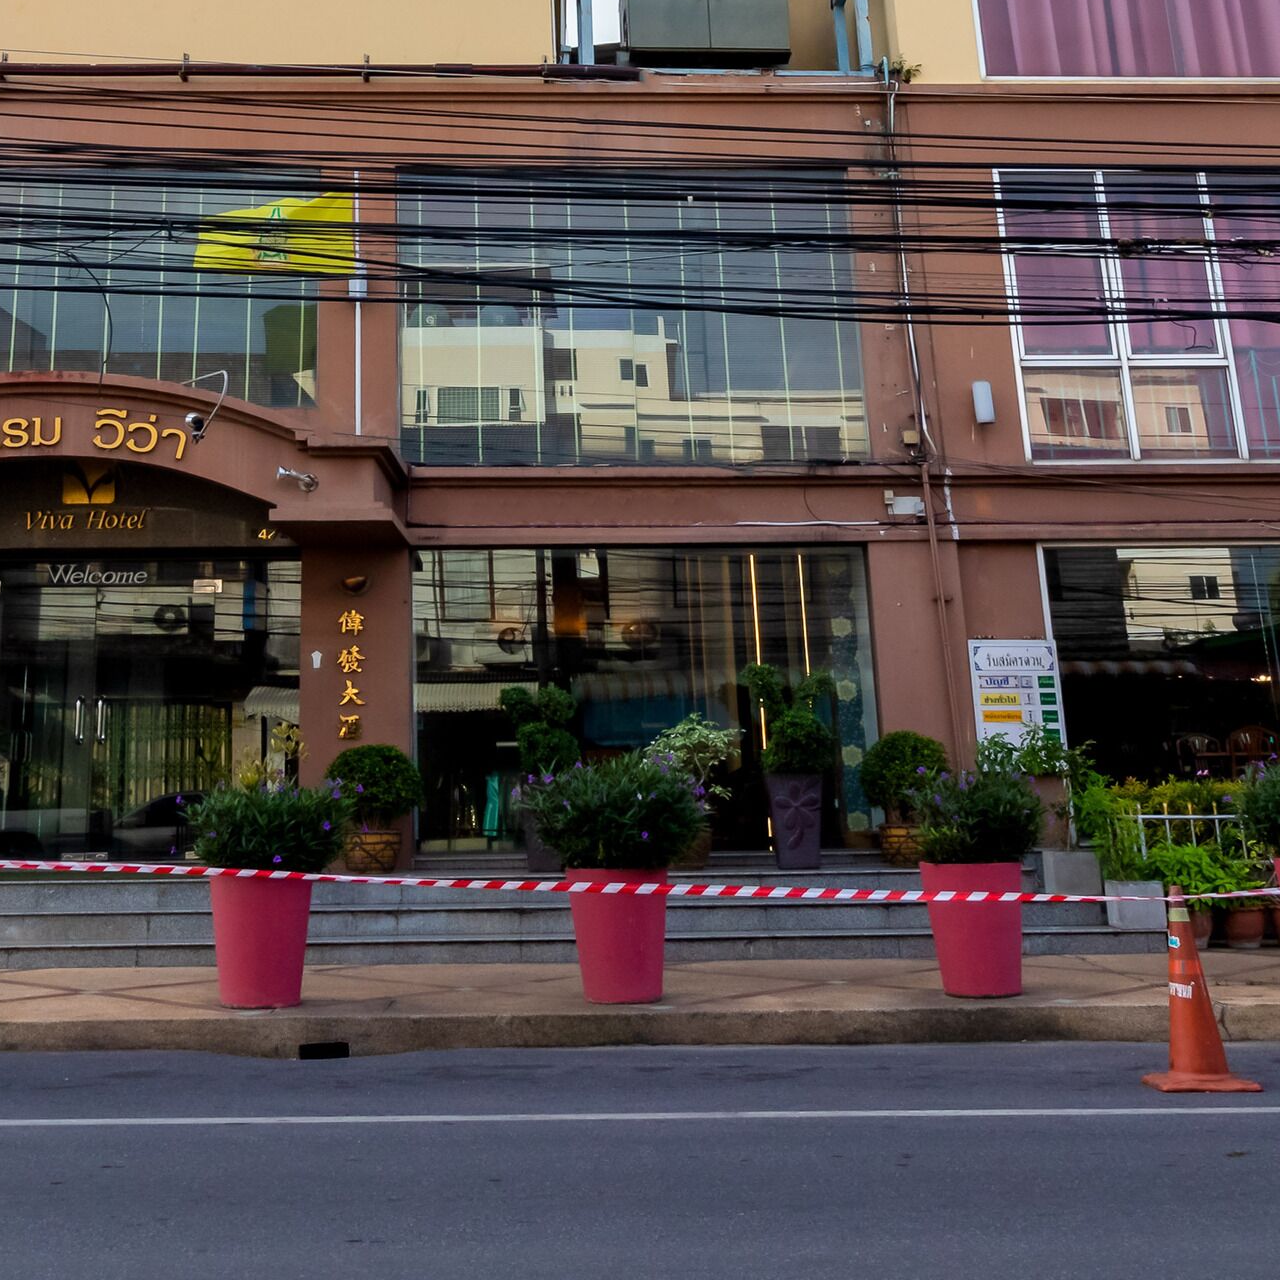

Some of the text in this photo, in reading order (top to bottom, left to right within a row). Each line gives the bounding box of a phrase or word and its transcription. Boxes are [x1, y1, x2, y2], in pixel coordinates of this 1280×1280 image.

[92, 407, 188, 460] วีว่า
[24, 509, 148, 531] Viva Hotel
[47, 564, 148, 585] Welcome
